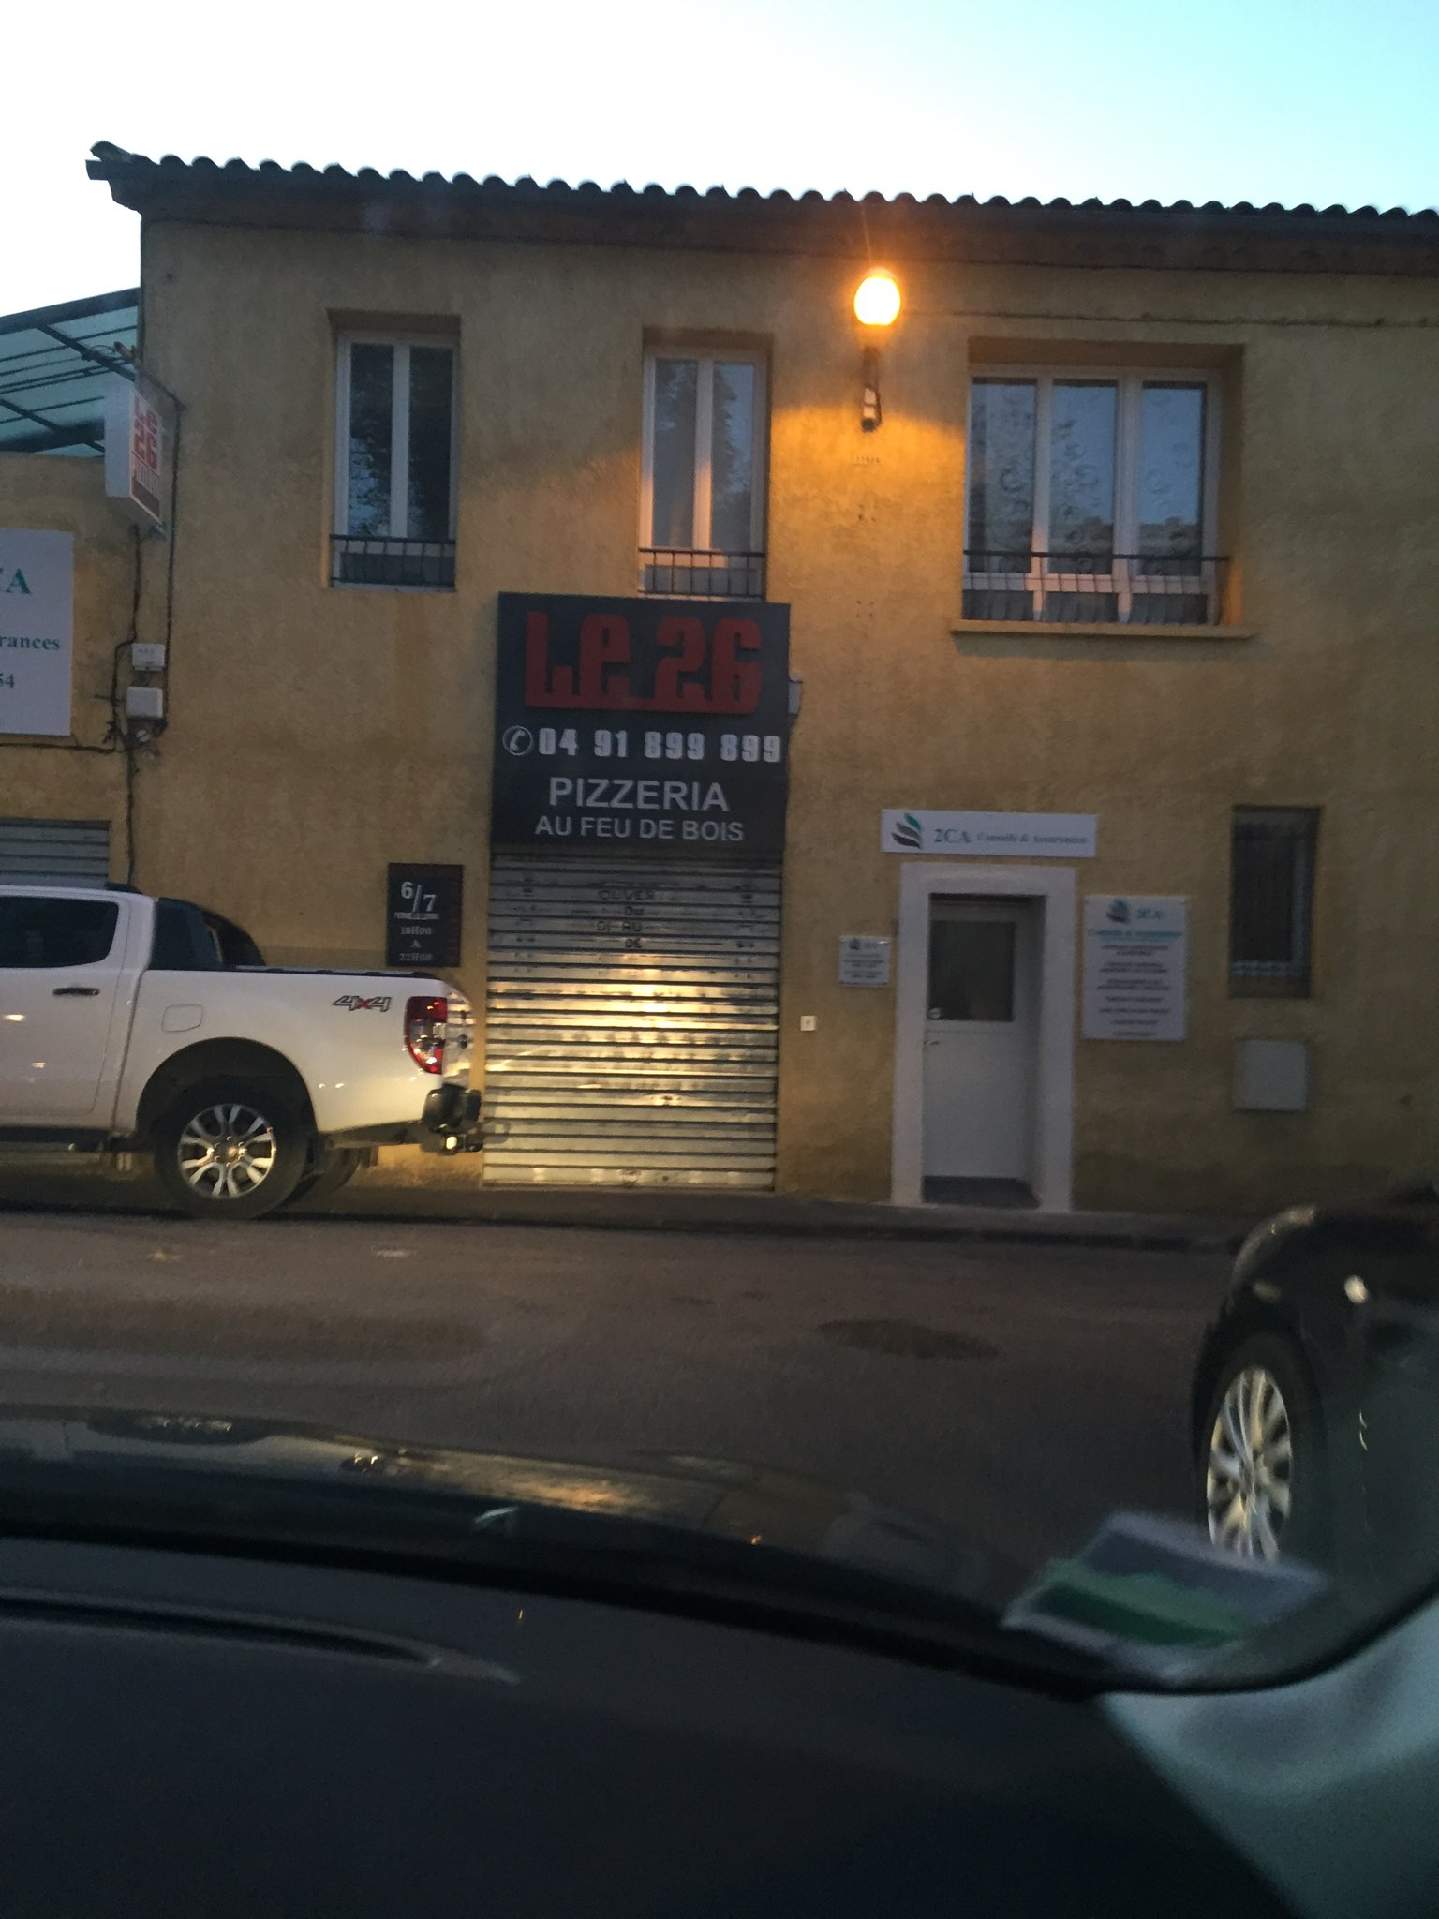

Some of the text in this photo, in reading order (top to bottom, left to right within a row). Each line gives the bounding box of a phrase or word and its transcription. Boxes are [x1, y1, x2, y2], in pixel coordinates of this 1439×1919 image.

[655, 616, 764, 713] 26
[538, 727, 782, 763] 04 91 899 899
[549, 777, 730, 812] PIZZERIA
[535, 816, 744, 841] AU FEU DE BOIS
[401, 881, 437, 912] 6/7
